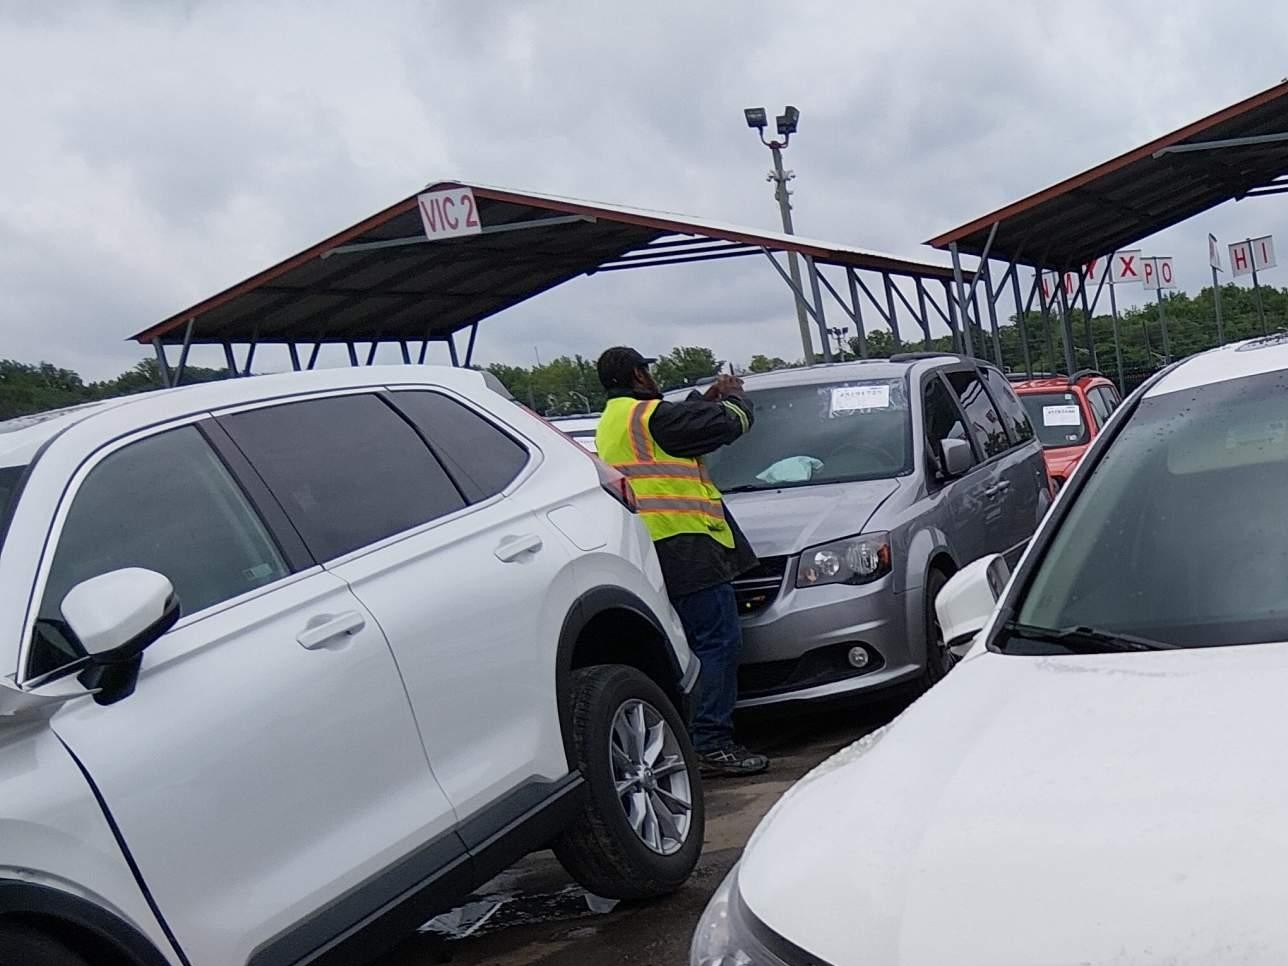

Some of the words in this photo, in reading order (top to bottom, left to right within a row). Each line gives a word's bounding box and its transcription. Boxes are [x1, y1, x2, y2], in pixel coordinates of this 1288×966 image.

[421, 197, 459, 232] VIC
[460, 194, 478, 228] 2
[1119, 255, 1138, 278] X
[1233, 247, 1248, 271] H
